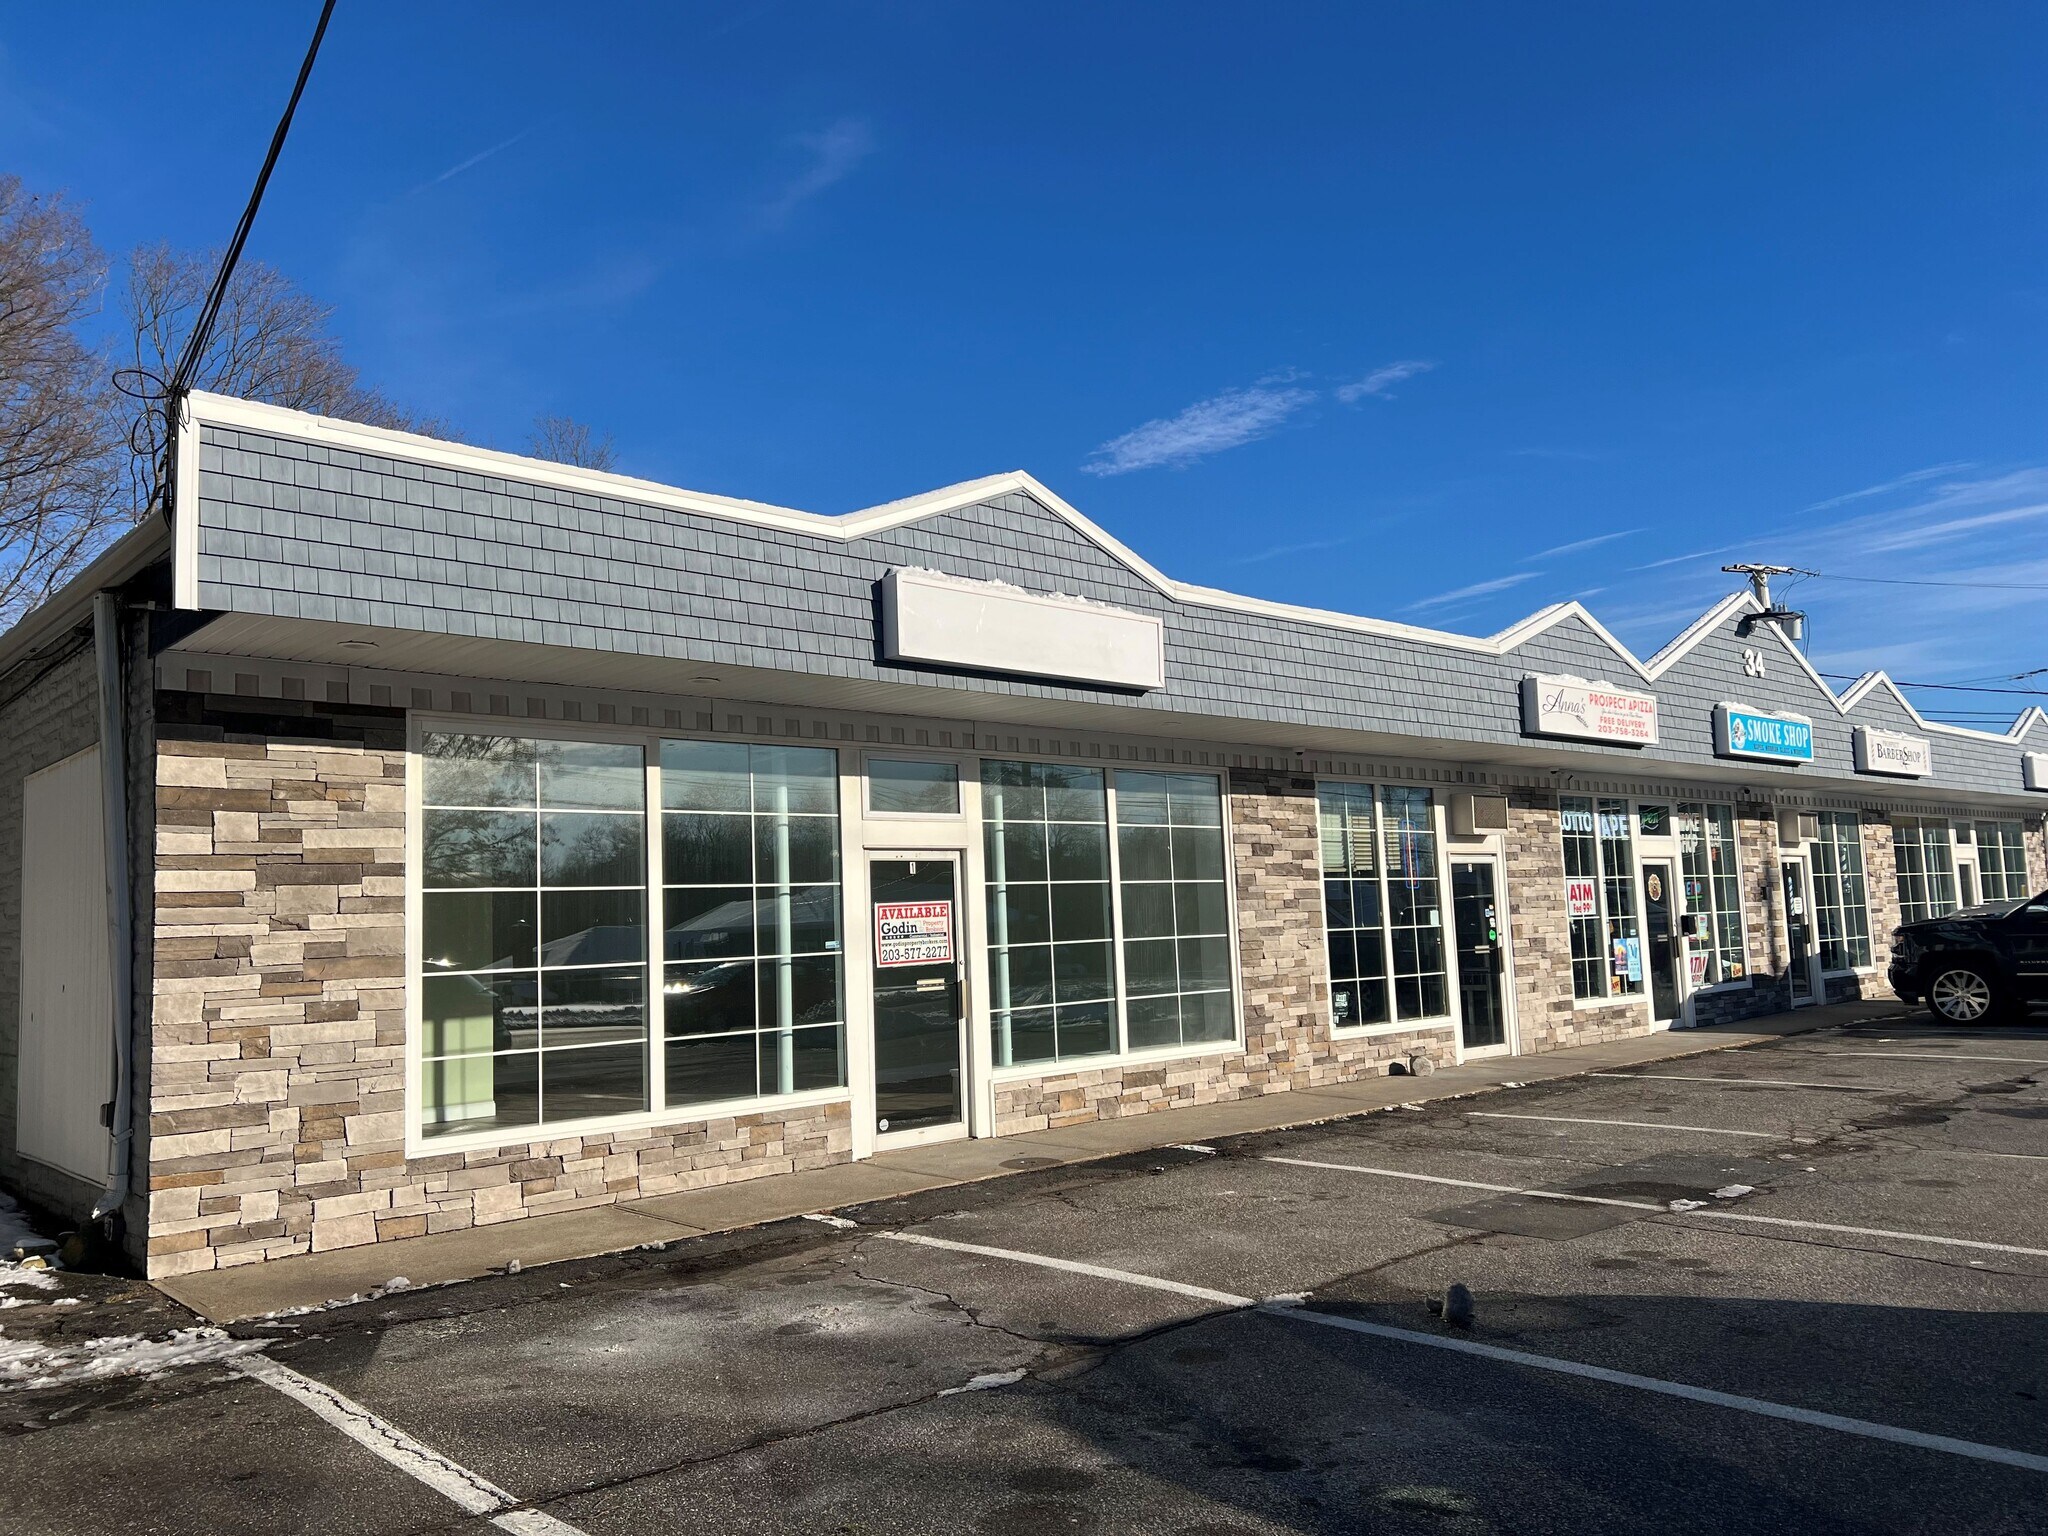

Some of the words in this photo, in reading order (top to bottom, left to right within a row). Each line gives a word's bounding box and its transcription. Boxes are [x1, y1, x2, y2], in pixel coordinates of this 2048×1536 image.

[1743, 648, 1766, 679] 34
[1542, 688, 1586, 714] Anna's
[1589, 693, 1627, 710] PROSPECT
[1628, 699, 1653, 714] APIZZA
[1599, 716, 1615, 726] FREE
[1617, 718, 1646, 729] DELIVERY
[1747, 718, 1782, 745] SMOKE
[1783, 724, 1809, 748] SHOP
[1599, 813, 1629, 840] APE
[1570, 884, 1593, 901] ATM
[880, 906, 947, 920] AVAILABLE
[881, 921, 918, 935] Godin
